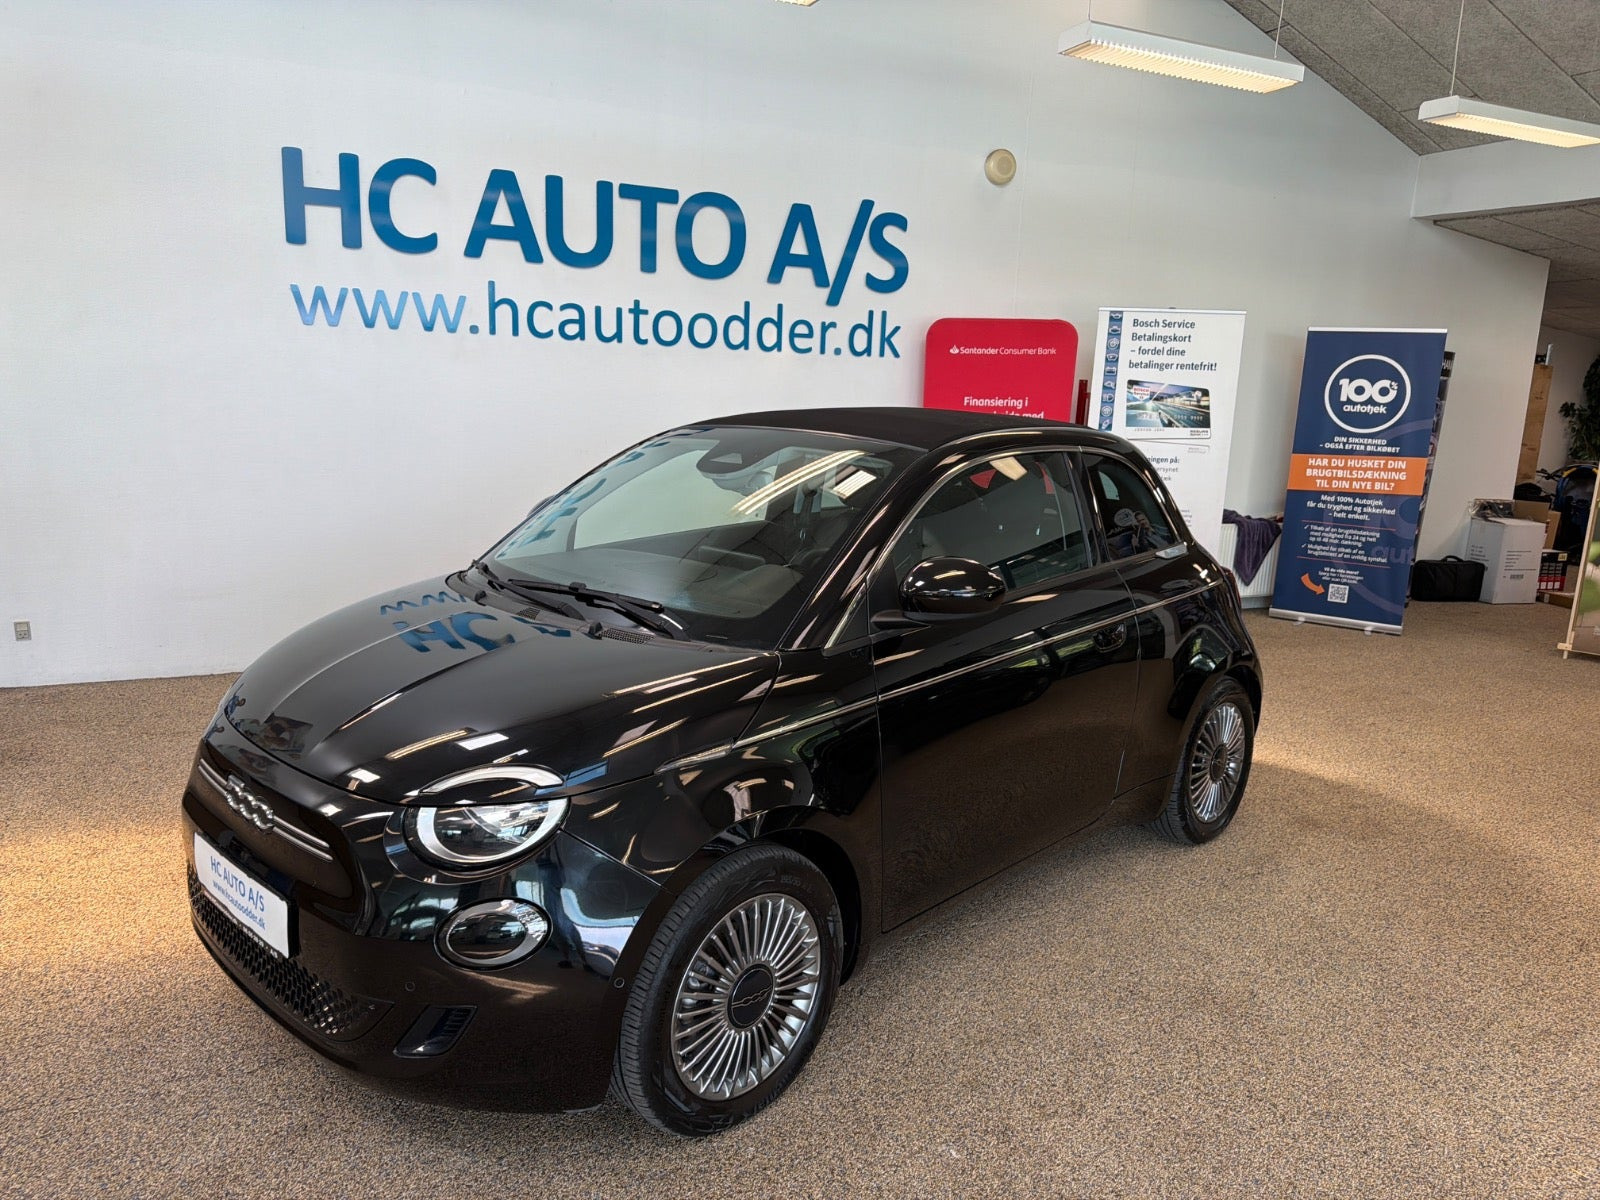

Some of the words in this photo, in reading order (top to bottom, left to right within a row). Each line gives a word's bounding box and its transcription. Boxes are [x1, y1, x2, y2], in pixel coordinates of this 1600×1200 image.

[281, 146, 438, 254] HC
[463, 168, 746, 279] AUTO
[767, 198, 909, 306] A/S
[290, 281, 901, 358] www.hcautoodder.dk
[1132, 318, 1160, 328] Bosch
[1161, 319, 1196, 329] Service
[1131, 332, 1192, 344] Betalingskort
[960, 346, 998, 355] Santander
[999, 346, 1037, 355] Consumer
[1037, 347, 1056, 356] Bank
[1138, 346, 1165, 356] fordel
[1166, 347, 1186, 356] dine
[1128, 360, 1174, 371] betalinger
[1176, 361, 1217, 372] rentefrit!
[963, 396, 1023, 409] Finansiering
[1025, 397, 1029, 407] i
[1343, 404, 1387, 415] autotjek
[1348, 437, 1387, 445] SIKKERHED
[1324, 442, 1344, 450] OGSÅ
[1366, 445, 1400, 453] BILKØBET
[1308, 458, 1328, 467] HAR
[1331, 458, 1345, 467] DU
[1348, 459, 1386, 469] HUSKET
[1387, 460, 1406, 469] DIN
[1306, 468, 1407, 480] BRUGTBILSDÆKNING
[1316, 480, 1330, 488] TIL
[1332, 480, 1350, 489] DIN
[1352, 481, 1372, 490] NYE
[1374, 482, 1395, 491] BIL?
[1320, 494, 1336, 502] Med
[1355, 498, 1383, 506] Autotjek
[1327, 504, 1352, 512] tryghed
[1363, 507, 1396, 515] sikkerhed
[210, 856, 222, 878] HC
[223, 868, 246, 898] AUTO
[248, 887, 265, 912] A/S
